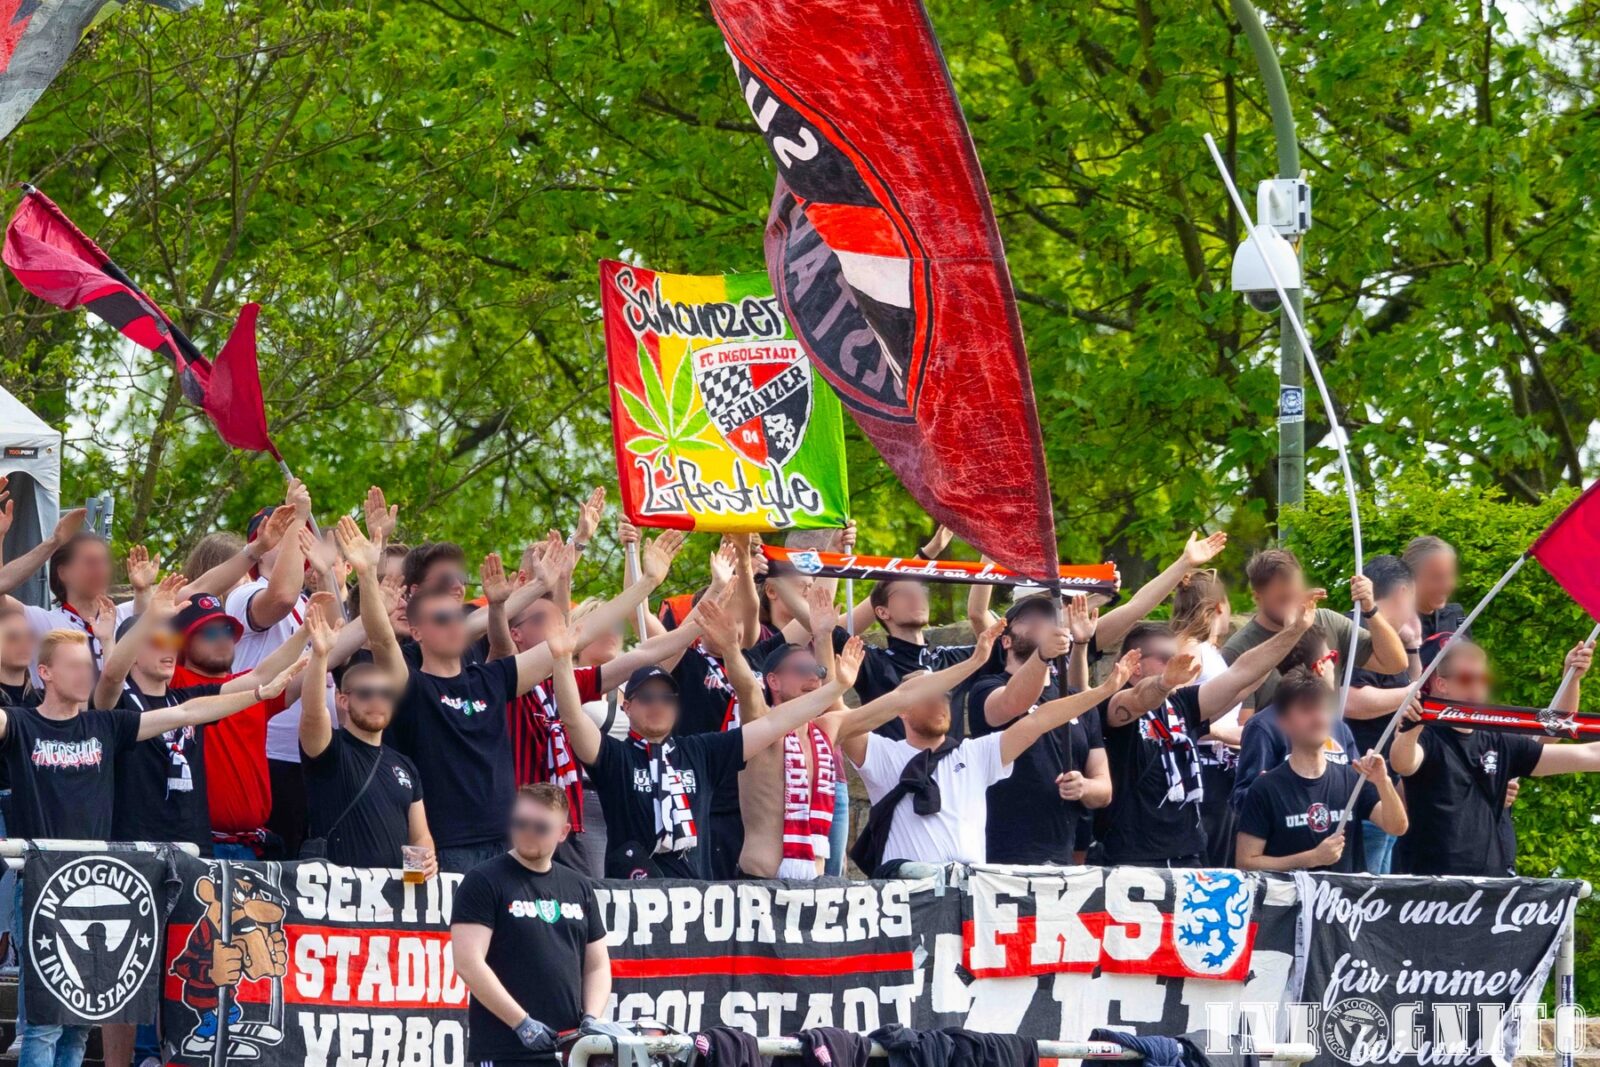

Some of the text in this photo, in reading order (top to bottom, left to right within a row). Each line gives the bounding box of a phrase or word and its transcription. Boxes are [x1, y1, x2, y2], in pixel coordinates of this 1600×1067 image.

[616, 268, 784, 339] Schanzer
[699, 353, 714, 368] FC
[718, 365, 807, 432] SCHANZER
[974, 562, 1008, 580] der
[39, 864, 151, 920] IN KOGNITO
[970, 866, 1166, 970] FKS
[1400, 889, 1483, 925] und
[1489, 886, 1566, 935] Lars
[39, 953, 145, 1013] INGOLSTADT
[295, 934, 470, 1003] STADIO
[1323, 953, 1389, 1012] für
[1396, 959, 1524, 997] immer
[299, 1012, 469, 1067] VERBO
